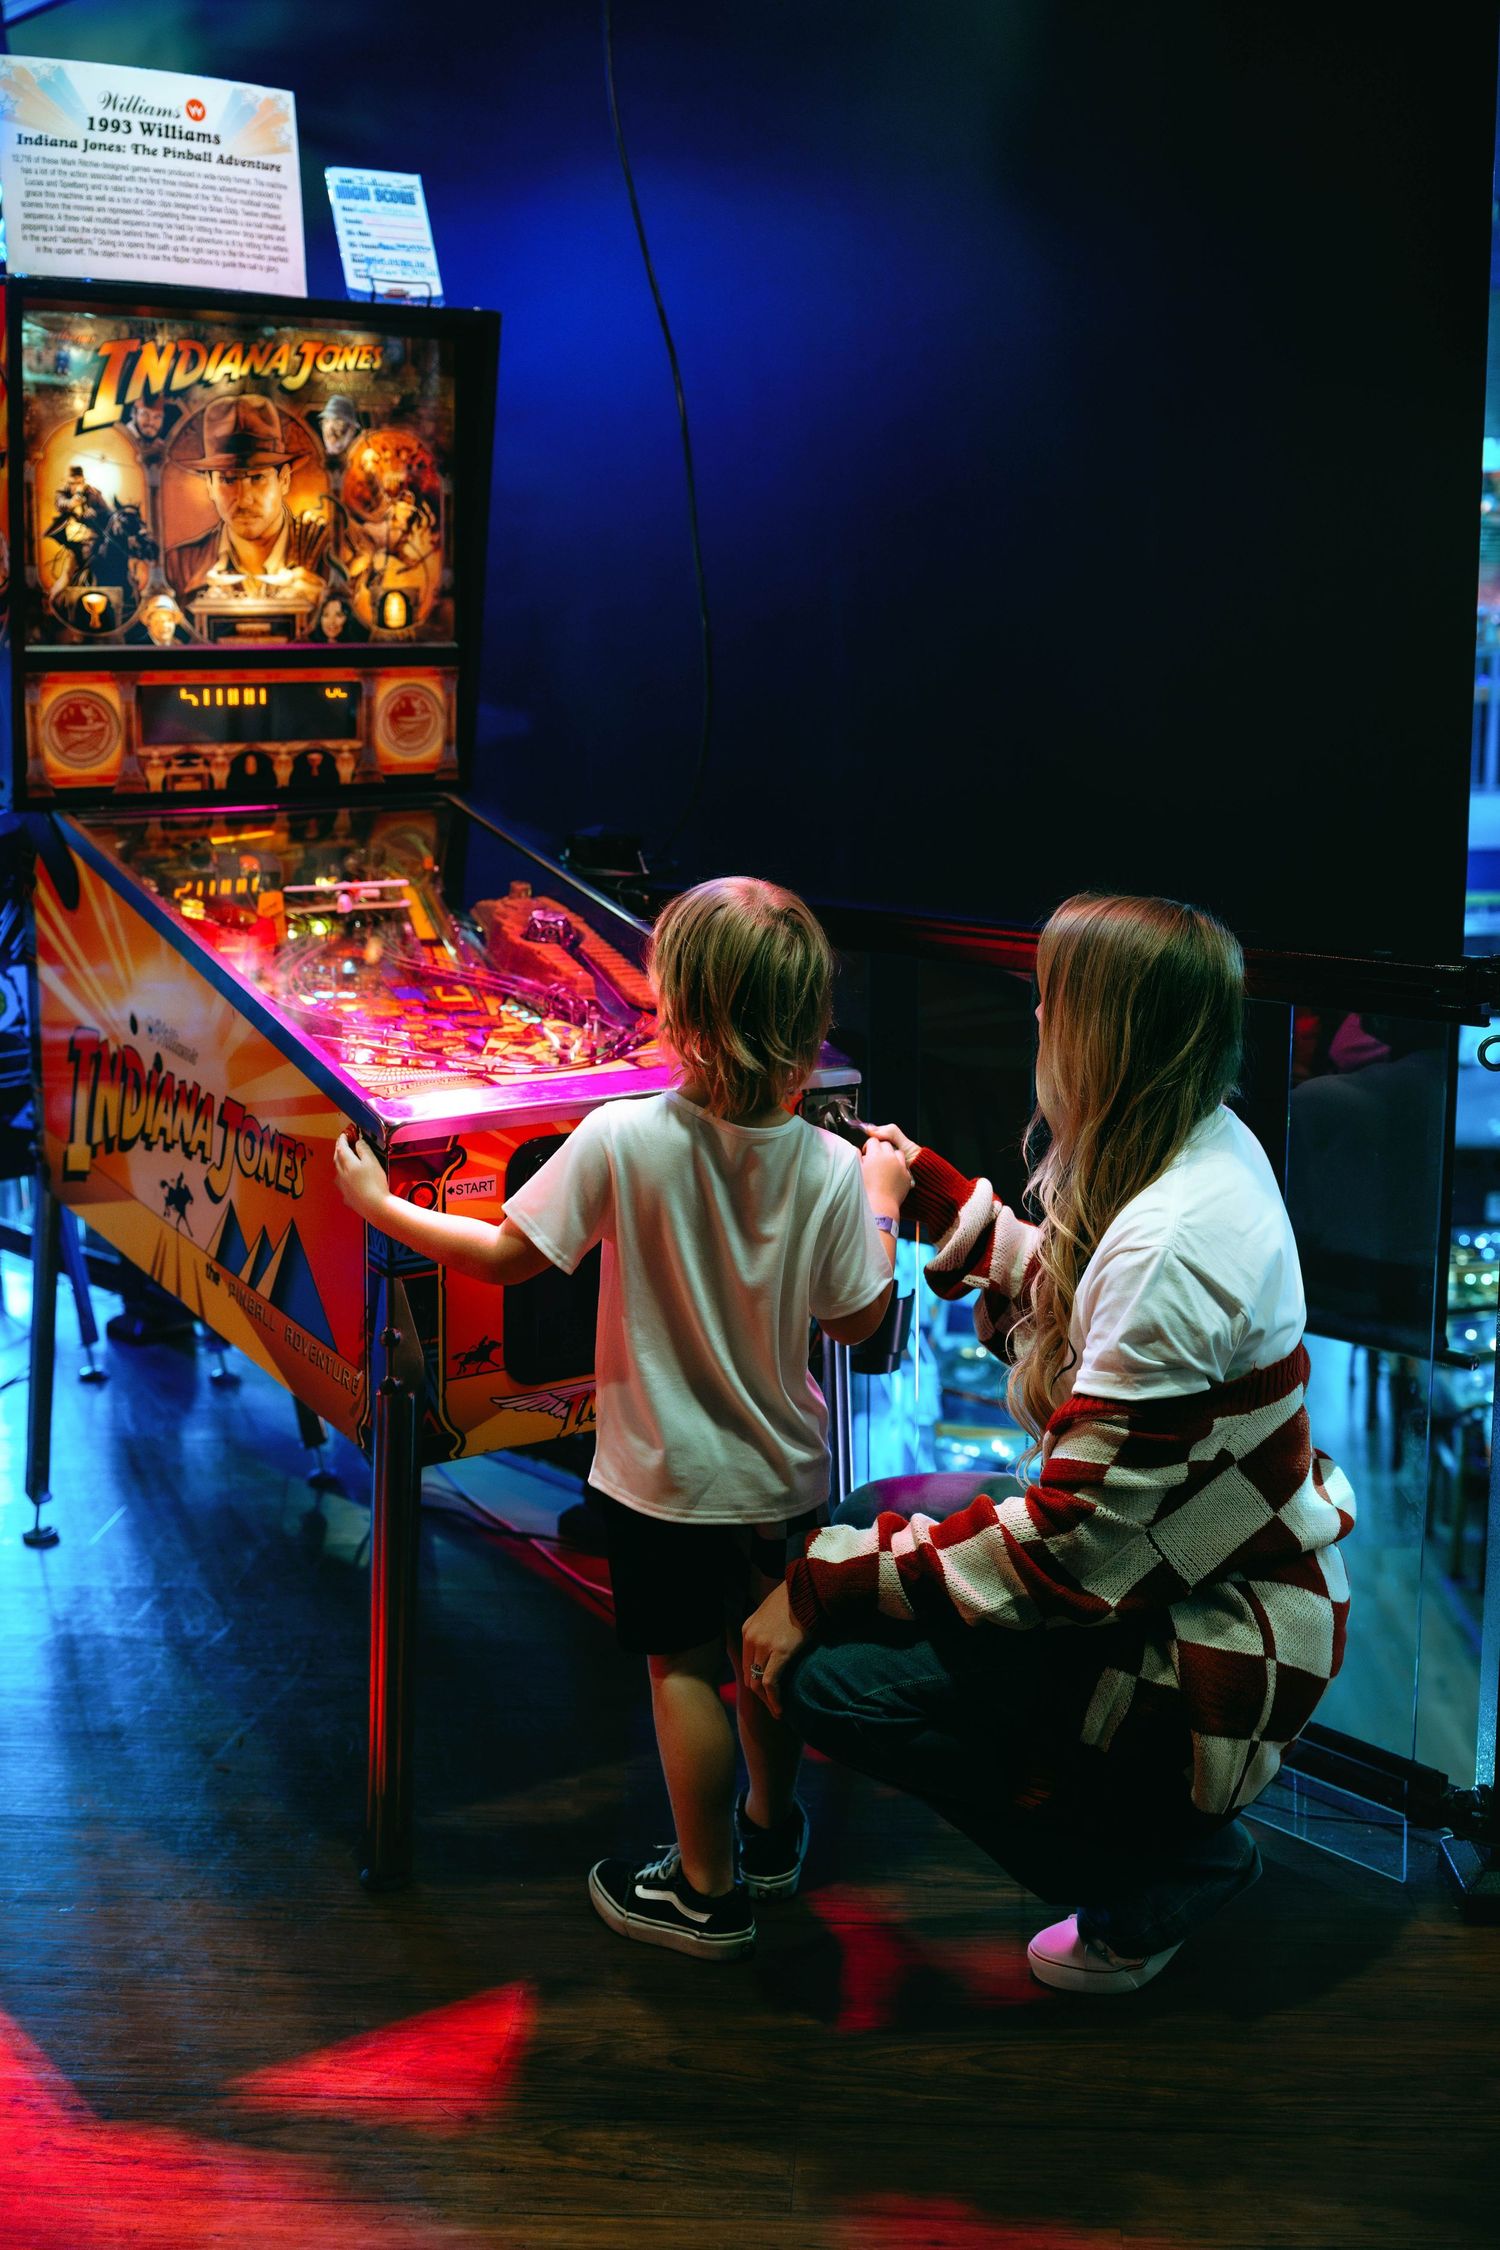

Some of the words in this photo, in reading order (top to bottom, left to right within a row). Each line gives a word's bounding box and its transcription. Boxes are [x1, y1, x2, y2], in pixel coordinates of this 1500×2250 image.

[98, 89, 181, 119] Williams
[87, 116, 133, 135] 1993
[139, 120, 221, 146] Williams
[16, 132, 78, 149] Indiana
[82, 138, 127, 154] Jones:
[131, 143, 158, 157] The
[163, 147, 212, 163] Pinball
[216, 153, 282, 173] Adventure
[77, 338, 291, 434] INDIANA
[280, 340, 385, 392] JONES
[64, 1025, 216, 1182] INDIANA
[204, 1096, 307, 1204] JONES
[455, 1179, 496, 1196] START
[206, 1263, 220, 1286] the
